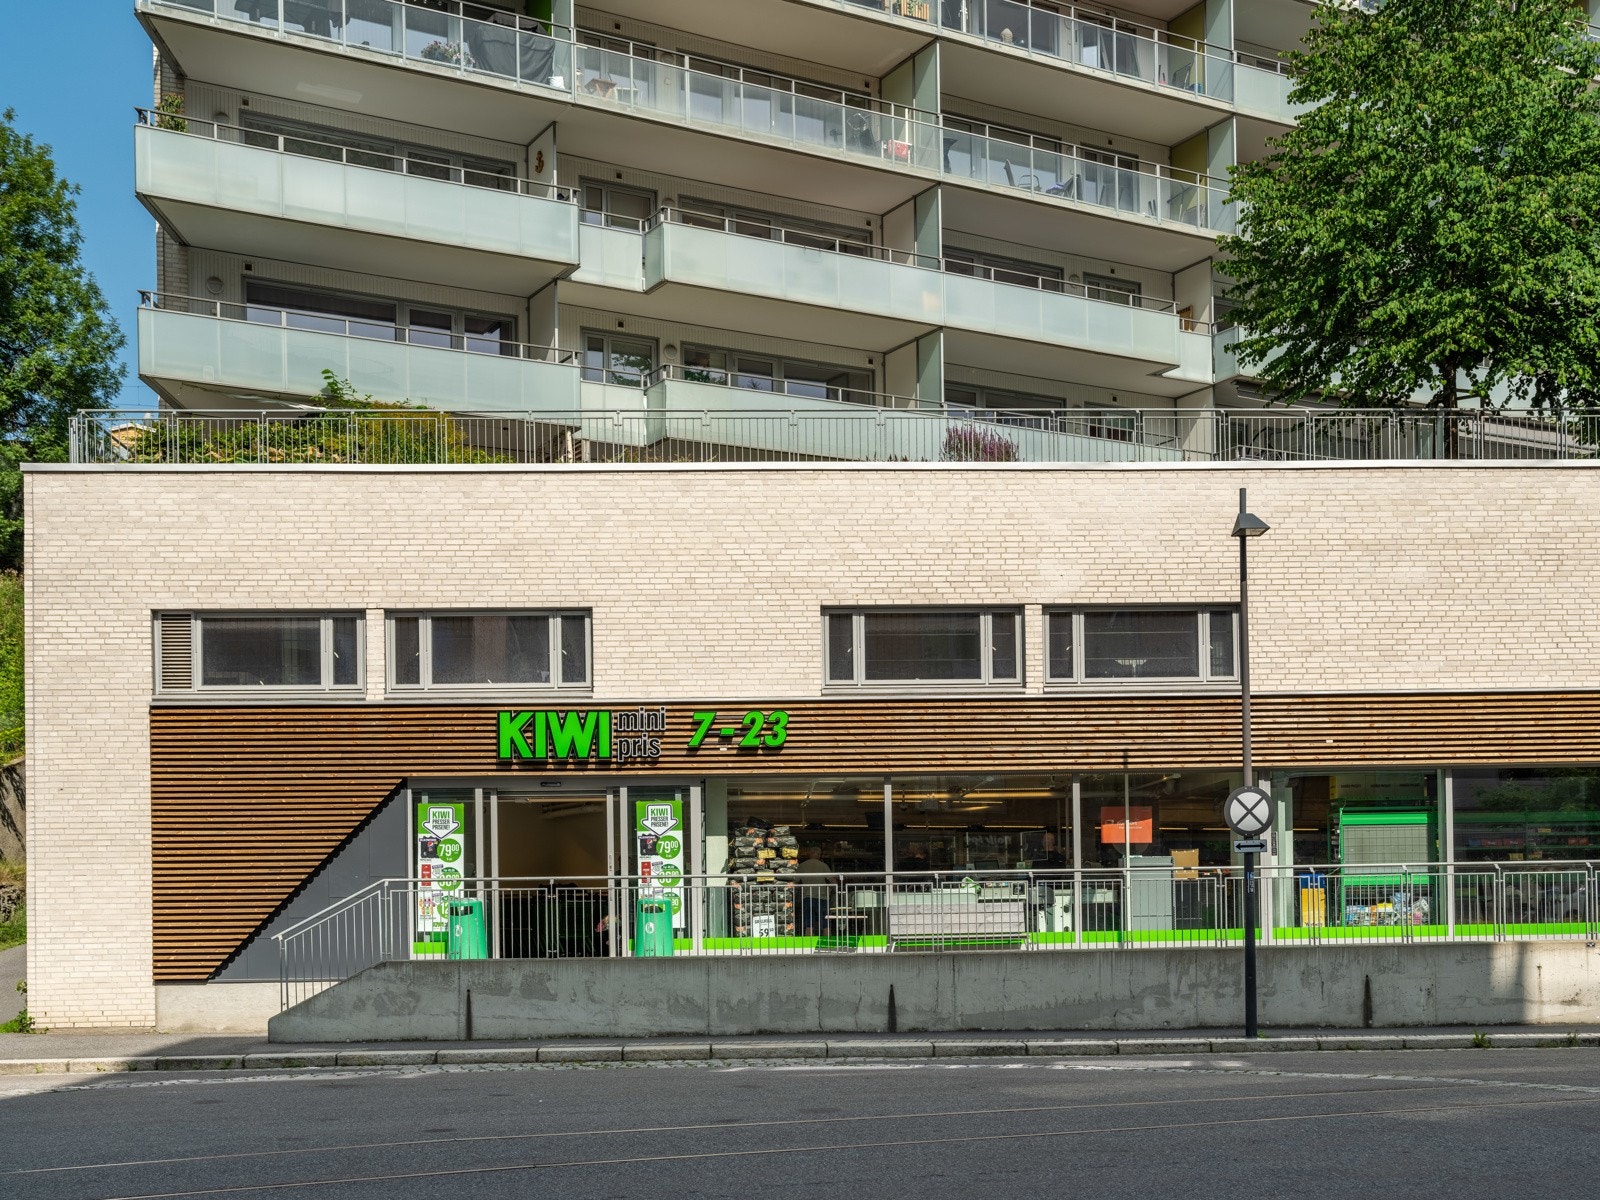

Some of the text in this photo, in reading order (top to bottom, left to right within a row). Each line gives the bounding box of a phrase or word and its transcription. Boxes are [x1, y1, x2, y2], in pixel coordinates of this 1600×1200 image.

[617, 706, 666, 731] mini
[498, 710, 612, 760] KIWI
[617, 733, 662, 762] pris
[432, 811, 450, 819] KIWI
[650, 808, 669, 816] KIWI
